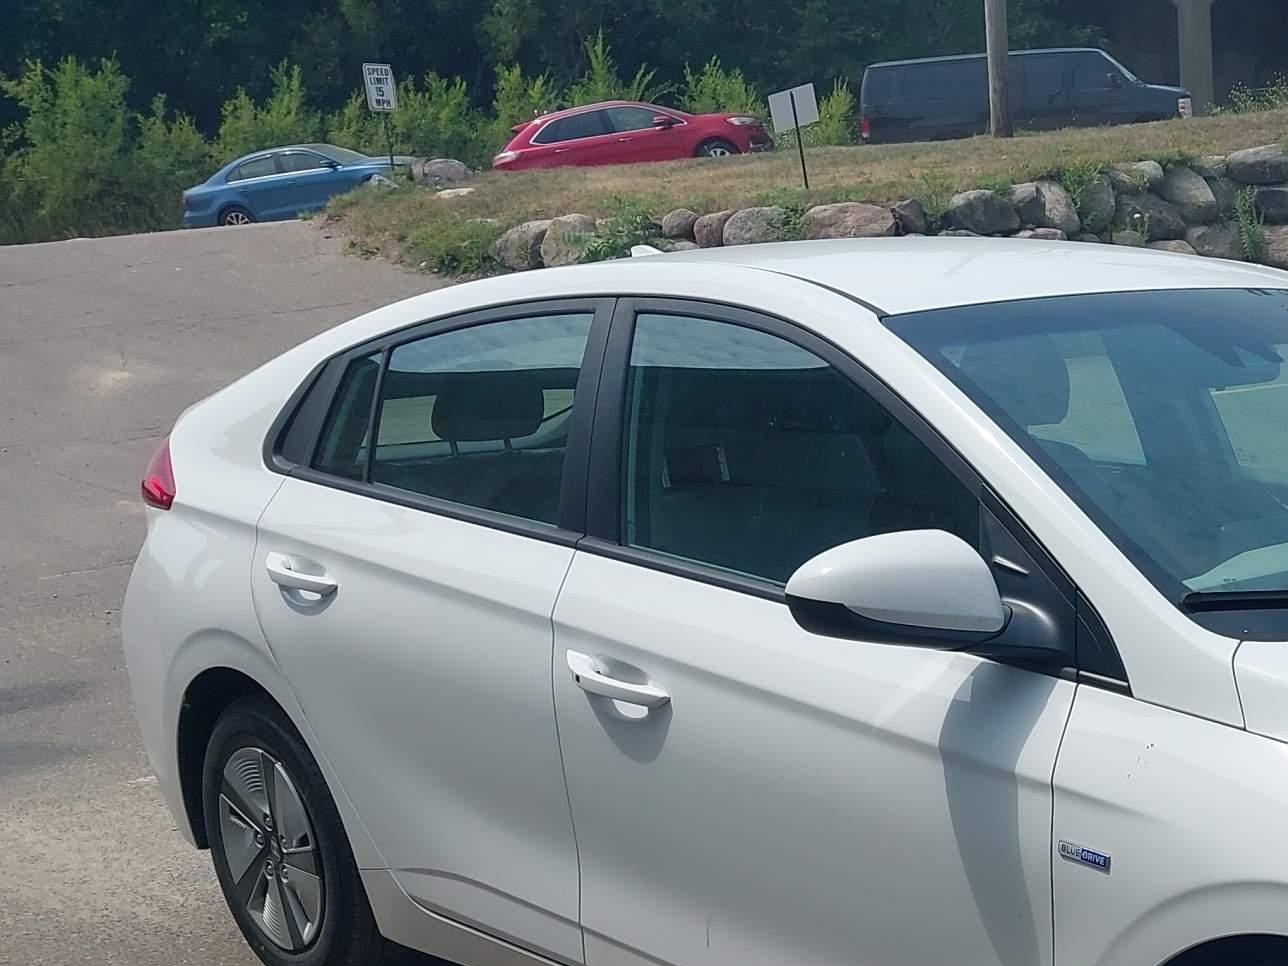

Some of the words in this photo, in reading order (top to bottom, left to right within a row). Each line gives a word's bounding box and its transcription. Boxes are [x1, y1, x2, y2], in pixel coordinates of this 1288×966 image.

[367, 67, 389, 76] SPEED
[370, 77, 388, 85] LIMIT
[375, 86, 385, 98] 15
[375, 98, 391, 108] MPH
[1081, 850, 1106, 866] DRIVE
